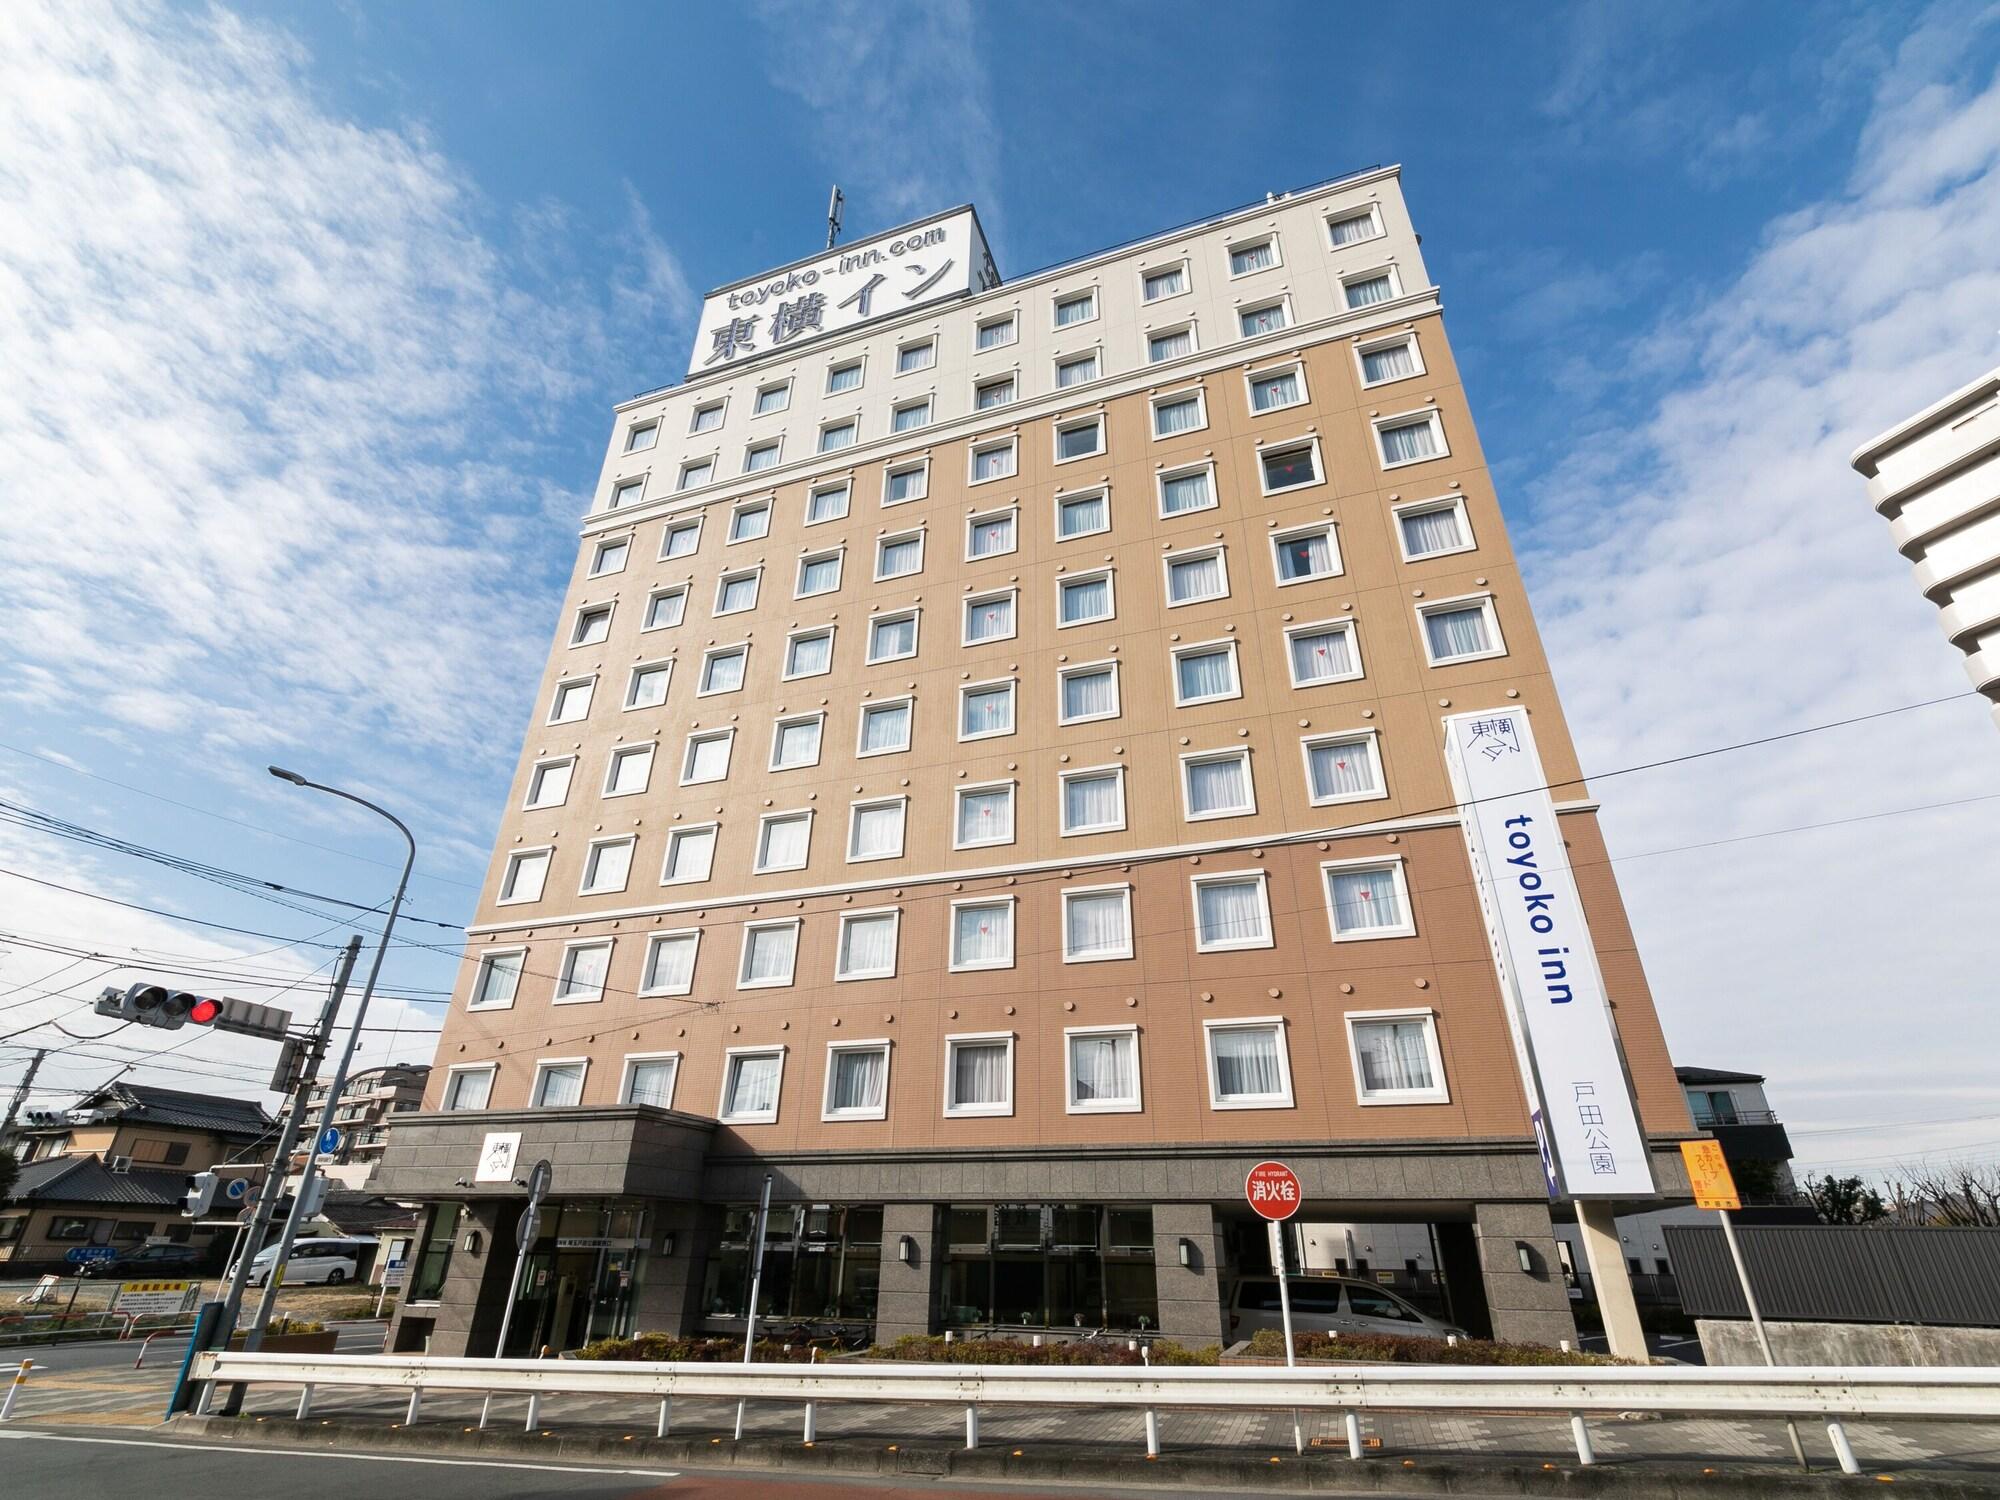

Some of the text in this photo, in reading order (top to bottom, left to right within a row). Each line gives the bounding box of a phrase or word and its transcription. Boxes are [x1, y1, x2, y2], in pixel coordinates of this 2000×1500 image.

[703, 258, 956, 366] 東横イン
[727, 227, 946, 310] toyoko-inn.com
[1504, 814, 1574, 1005] toyoko inn
[1571, 1081, 1617, 1175] 戸田公園
[1251, 1179, 1296, 1201] 消火栓
